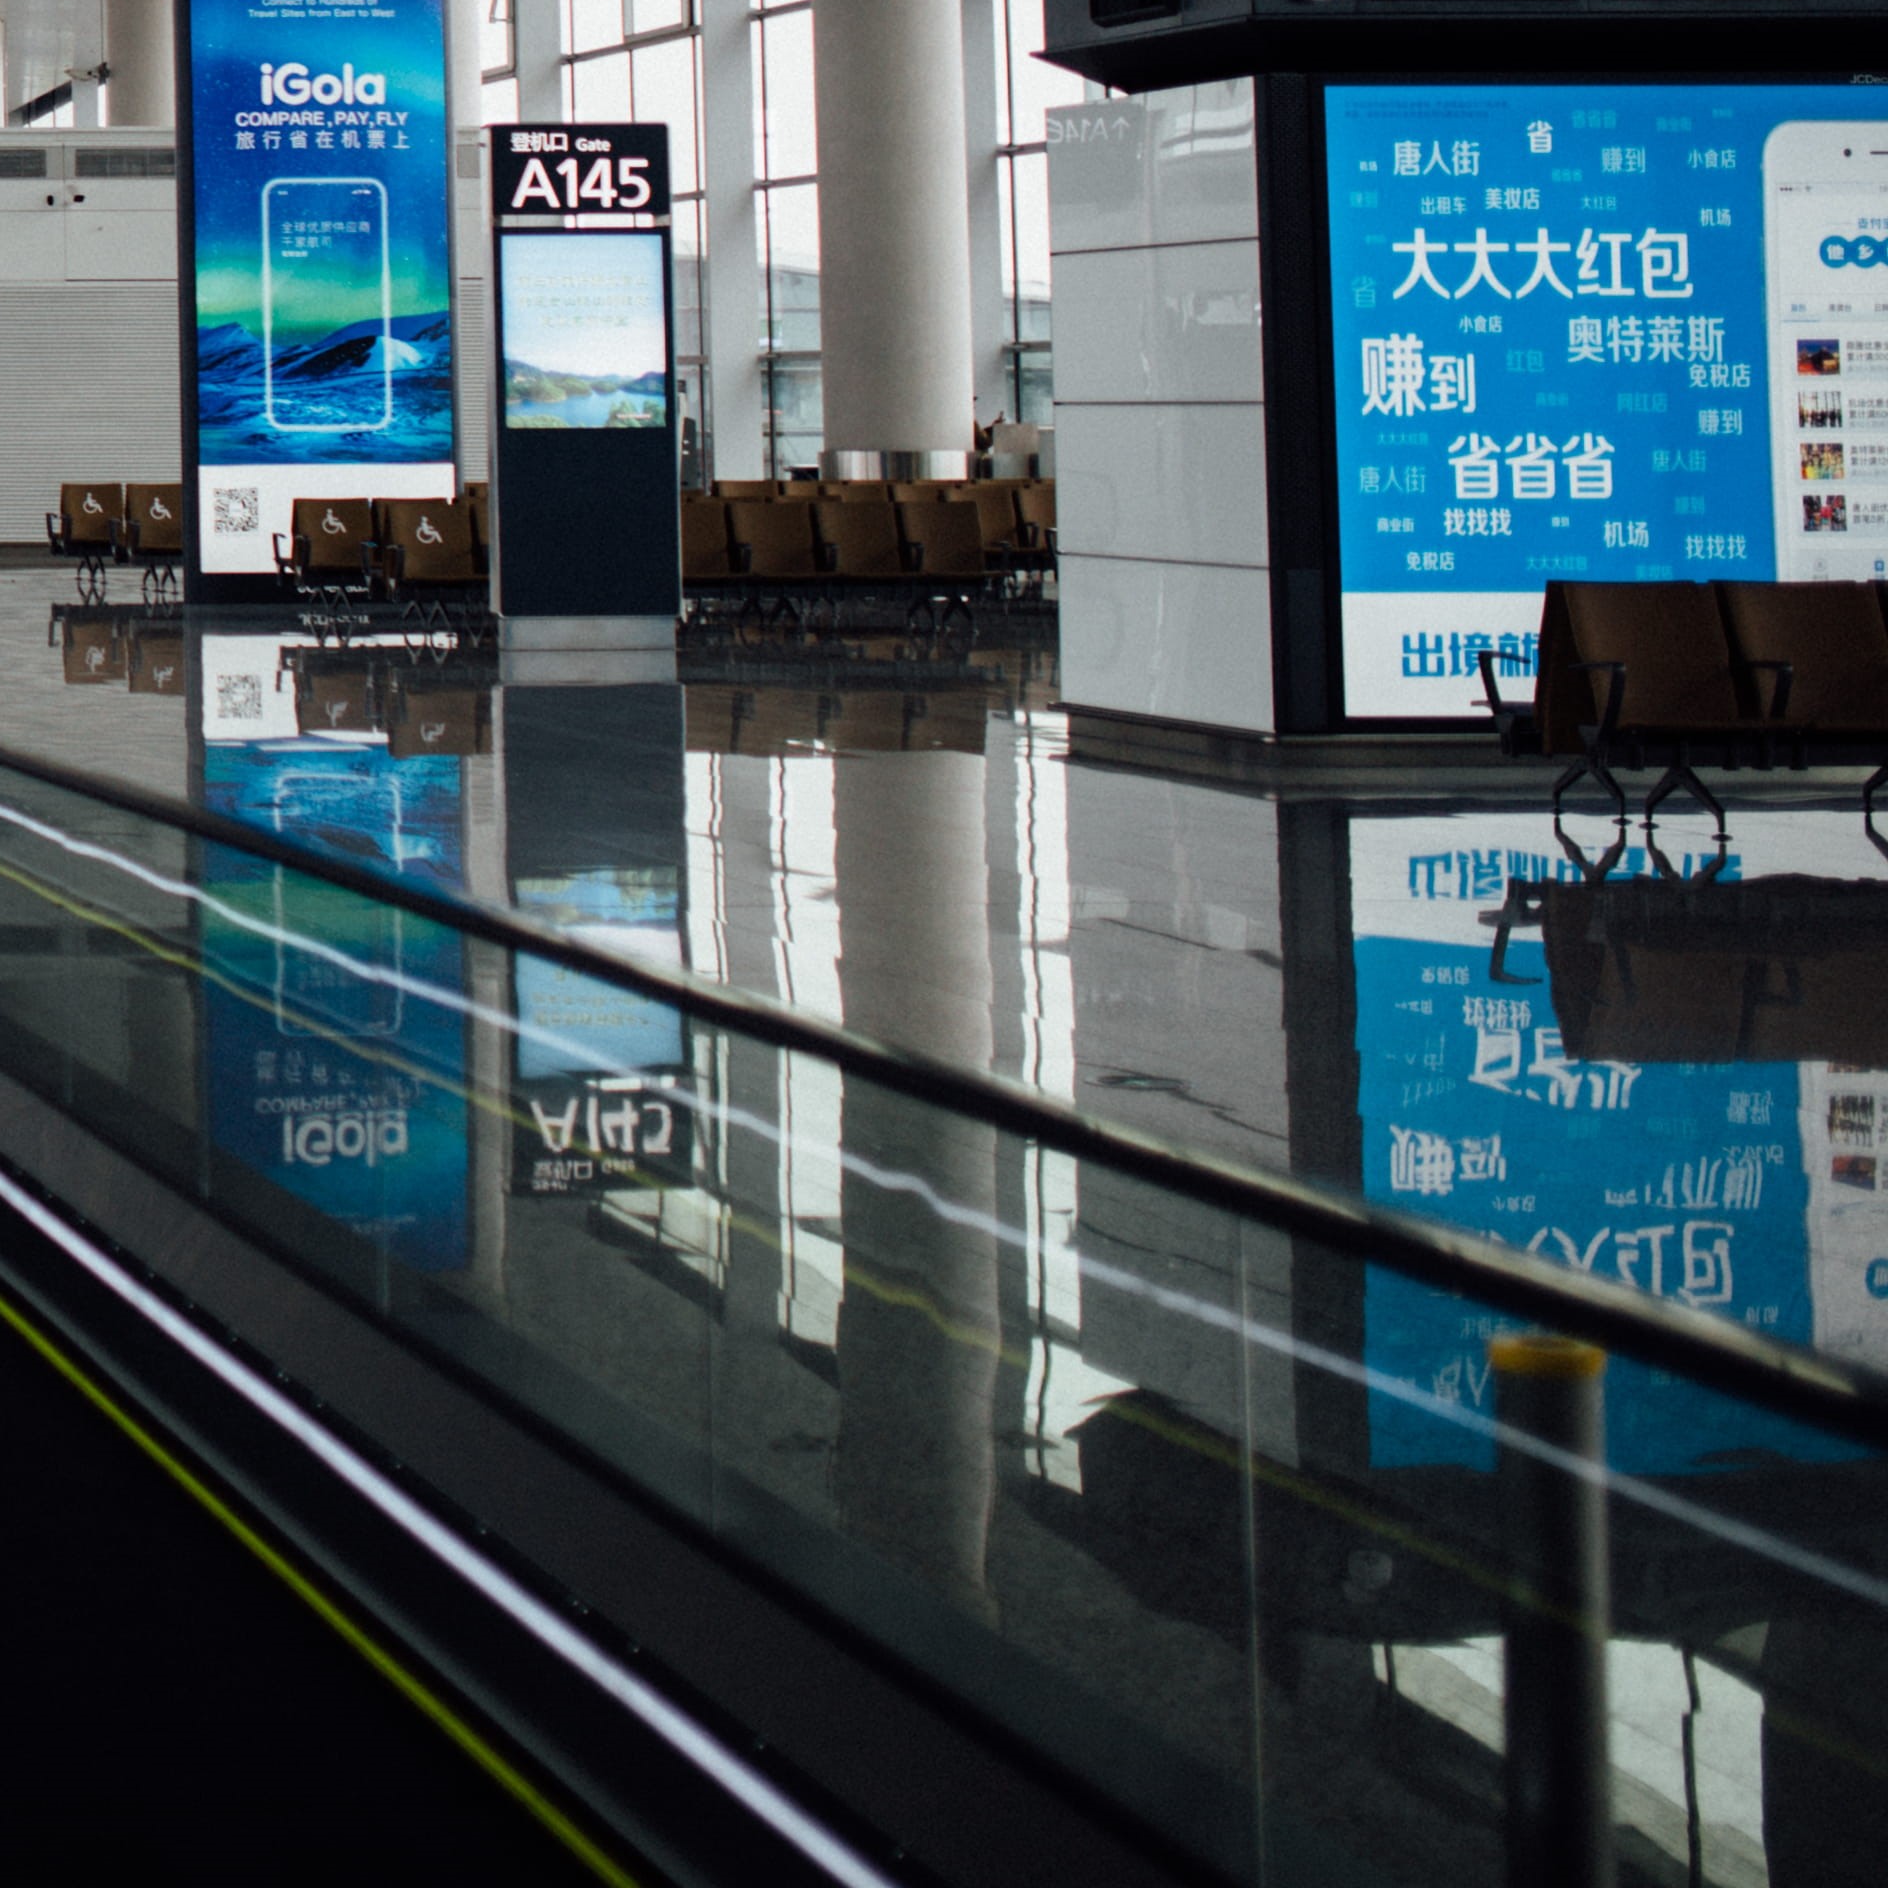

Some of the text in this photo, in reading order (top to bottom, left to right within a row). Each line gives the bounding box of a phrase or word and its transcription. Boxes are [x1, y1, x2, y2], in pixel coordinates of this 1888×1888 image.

[248, 9, 278, 18] Travel
[308, 9, 331, 18] from
[334, 9, 356, 18] East
[358, 10, 369, 18] to
[260, 62, 386, 105] iGola
[234, 130, 411, 150] 旅行省在机票上
[510, 132, 611, 152] 登机口 Gate
[1527, 120, 1554, 153] 省
[1394, 140, 1480, 176] 唐人街
[1601, 146, 1646, 173] 赚到
[1688, 149, 1736, 168] 小食店
[511, 158, 651, 208] A145
[1421, 196, 1467, 214] 出租车
[1485, 188, 1540, 210] 美妆店
[1700, 208, 1732, 227] 机场
[1392, 227, 1694, 300] 大大大红包
[1352, 275, 1376, 308] 省
[1459, 315, 1503, 333] 小食店
[1568, 316, 1725, 363] 奥特莱斯
[1505, 349, 1545, 372] 红包
[1361, 333, 1476, 417] 赚到
[1689, 363, 1751, 388] 免税店
[1698, 409, 1743, 435] 赚到
[1448, 433, 1615, 499] 省省省
[1652, 449, 1706, 472] 唐人街
[1359, 466, 1426, 493] 唐人街
[1443, 508, 1512, 536] 找找找
[1604, 520, 1649, 548] 机场
[1686, 535, 1747, 559] 找找找
[1406, 551, 1455, 571] 免税店
